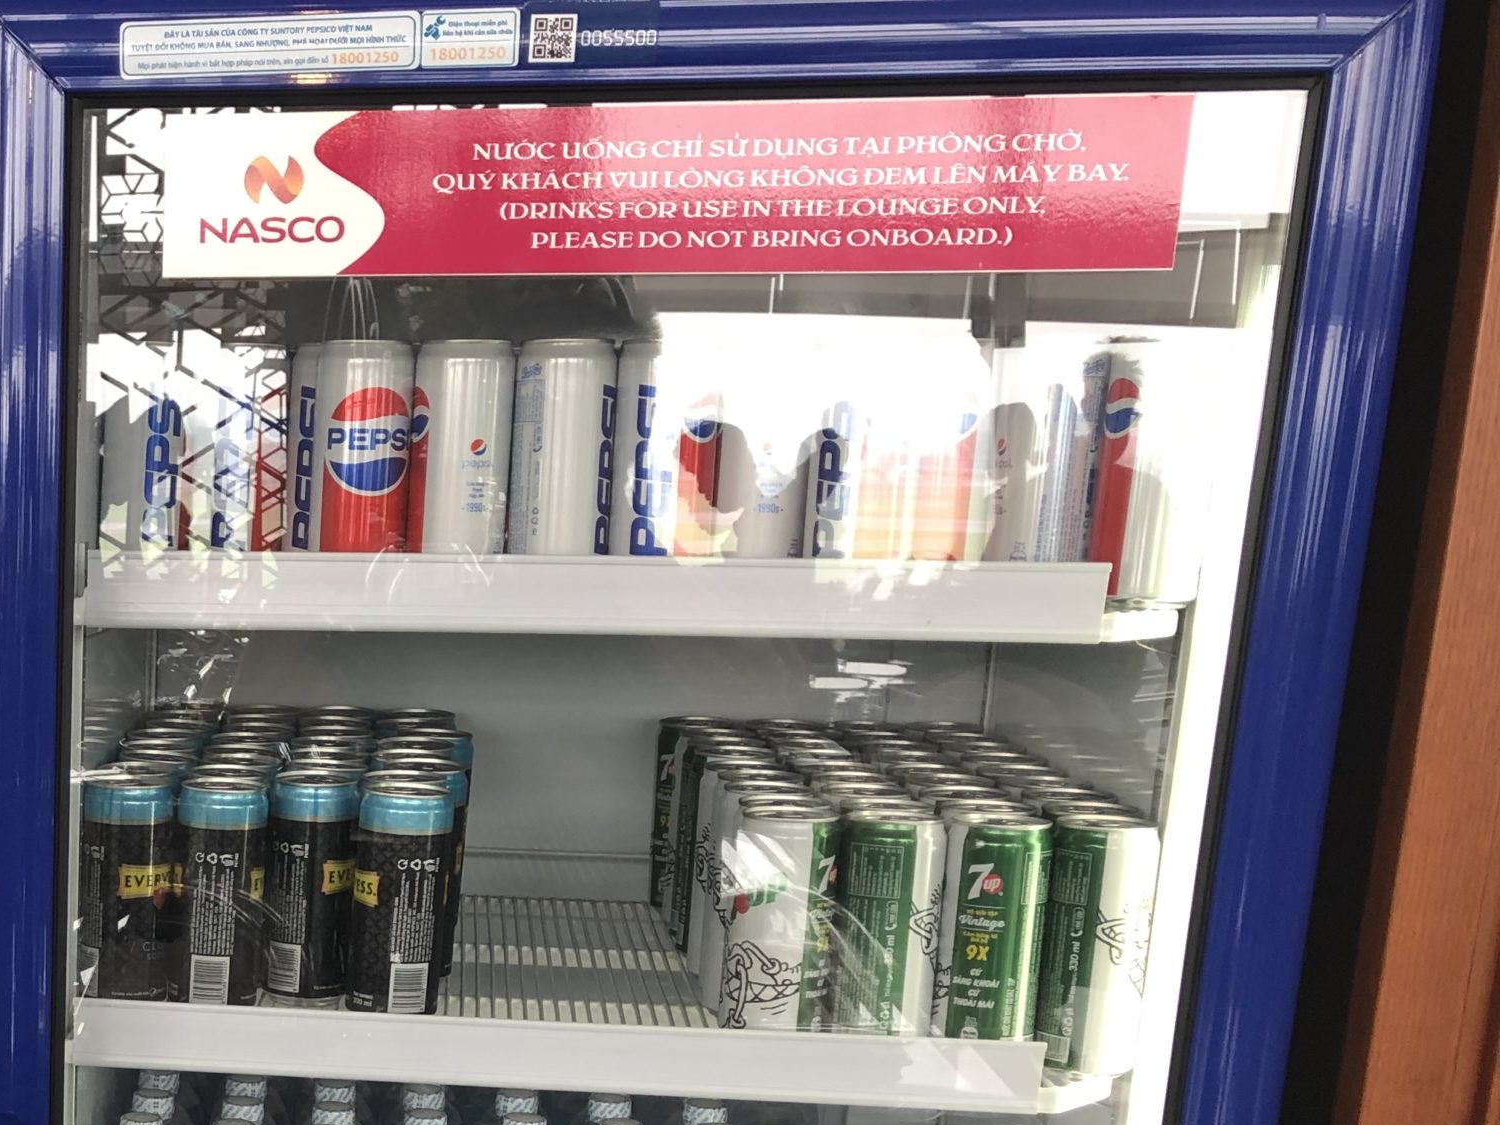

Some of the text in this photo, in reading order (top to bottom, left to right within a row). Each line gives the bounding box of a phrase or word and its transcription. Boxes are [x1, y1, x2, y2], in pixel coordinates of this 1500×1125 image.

[332, 50, 400, 65] 18001250
[431, 46, 507, 61] 18001250
[562, 136, 647, 161] UỐNG
[752, 138, 838, 162] DỤNG
[843, 138, 892, 160] TẠI
[896, 131, 1007, 157] PHÒNG
[432, 170, 500, 195] QUÝ
[502, 167, 602, 190] KHÁCH
[608, 170, 658, 190] VUI
[662, 165, 745, 189] LÒNG
[749, 163, 860, 188] KHÔNG
[864, 166, 928, 186] ĐEM
[933, 160, 988, 186] LÊN
[993, 161, 1063, 184] MÁY
[499, 200, 613, 222] (DRINKS
[619, 200, 678, 219] FOR
[682, 198, 736, 218] USE
[740, 199, 776, 217] IN
[779, 198, 834, 218] THE
[837, 196, 959, 217] LOUNGE
[199, 215, 346, 244] NASCO
[530, 230, 633, 250] PLEASE
[637, 230, 682, 249] DO
[687, 228, 747, 249] NOT
[751, 227, 841, 248] BRING
[958, 914, 1006, 931] Vintage
[965, 943, 990, 961] 9X
